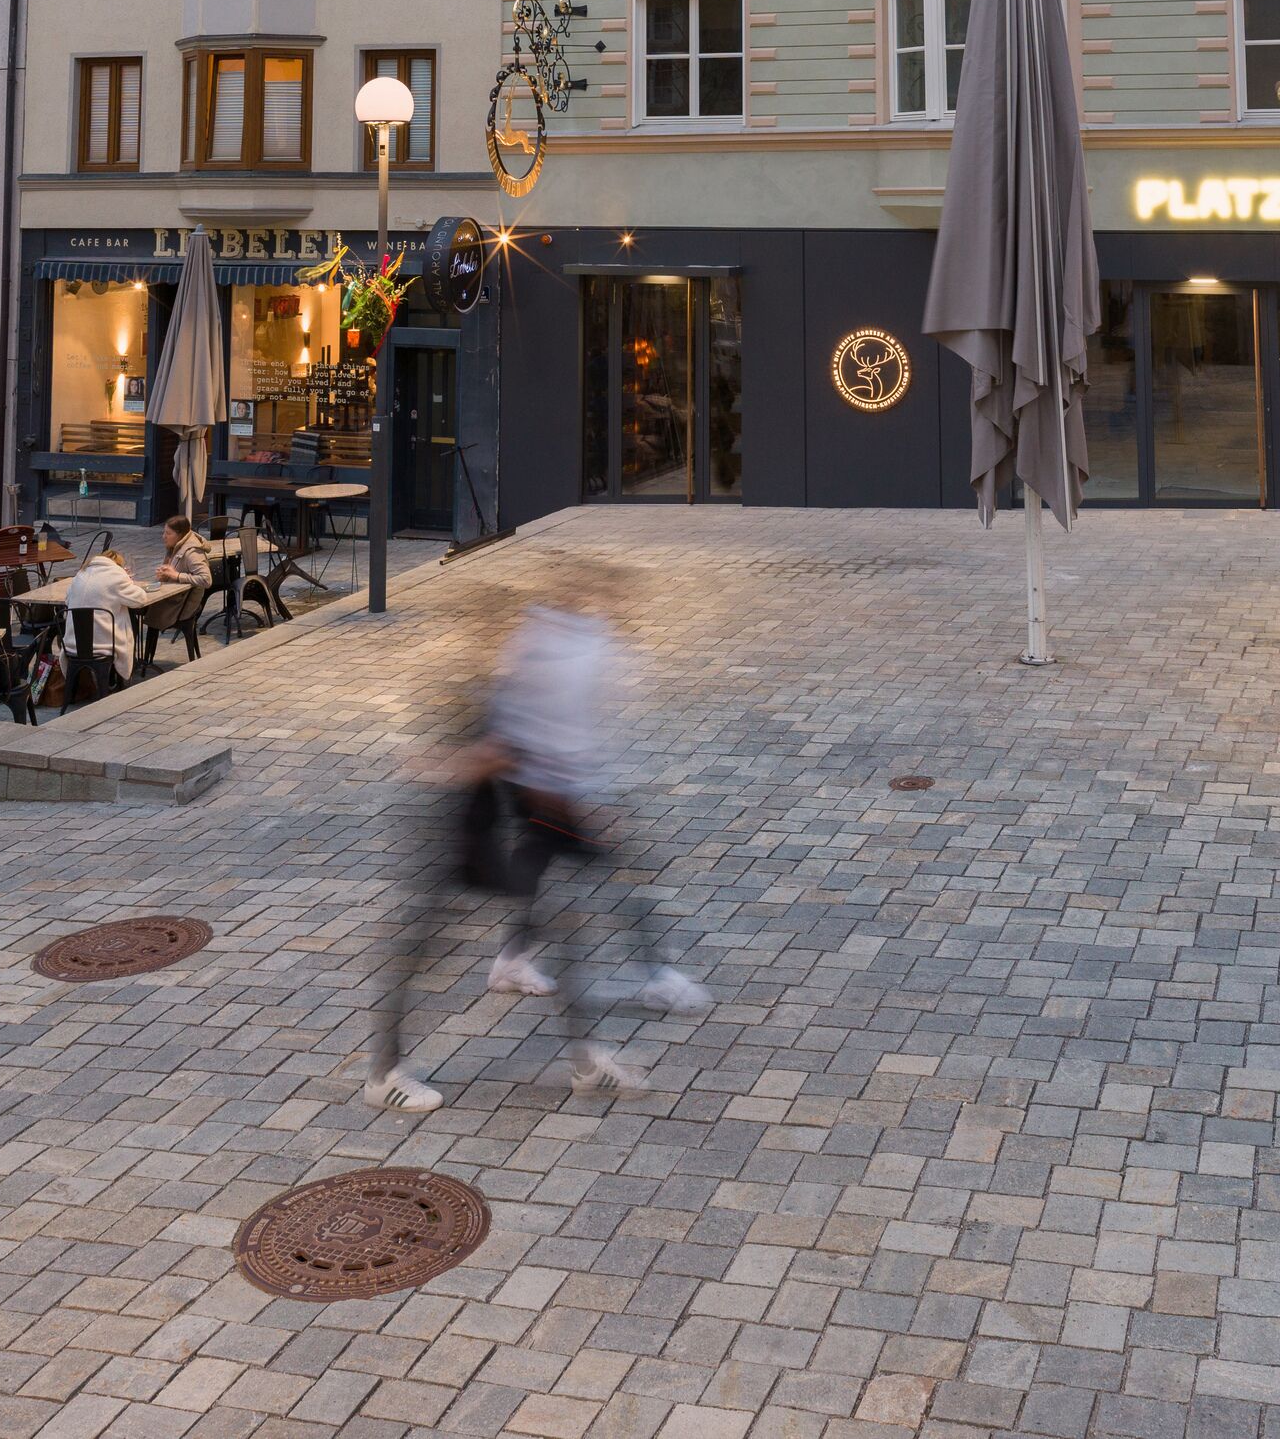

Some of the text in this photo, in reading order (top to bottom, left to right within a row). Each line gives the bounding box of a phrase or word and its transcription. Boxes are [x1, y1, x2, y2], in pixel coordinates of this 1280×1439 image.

[70, 237, 130, 247] CAFE BAR
[367, 241, 426, 251] WNE BA
[432, 231, 447, 276] AROUND
[839, 334, 855, 349] ERSTE
[856, 330, 885, 338] ADRESSE
[886, 336, 896, 344] AM
[895, 344, 908, 364] PLATZ
[342, 362, 370, 371] things
[274, 368, 288, 376] how
[256, 376, 283, 385] gently
[283, 386, 306, 394] fully
